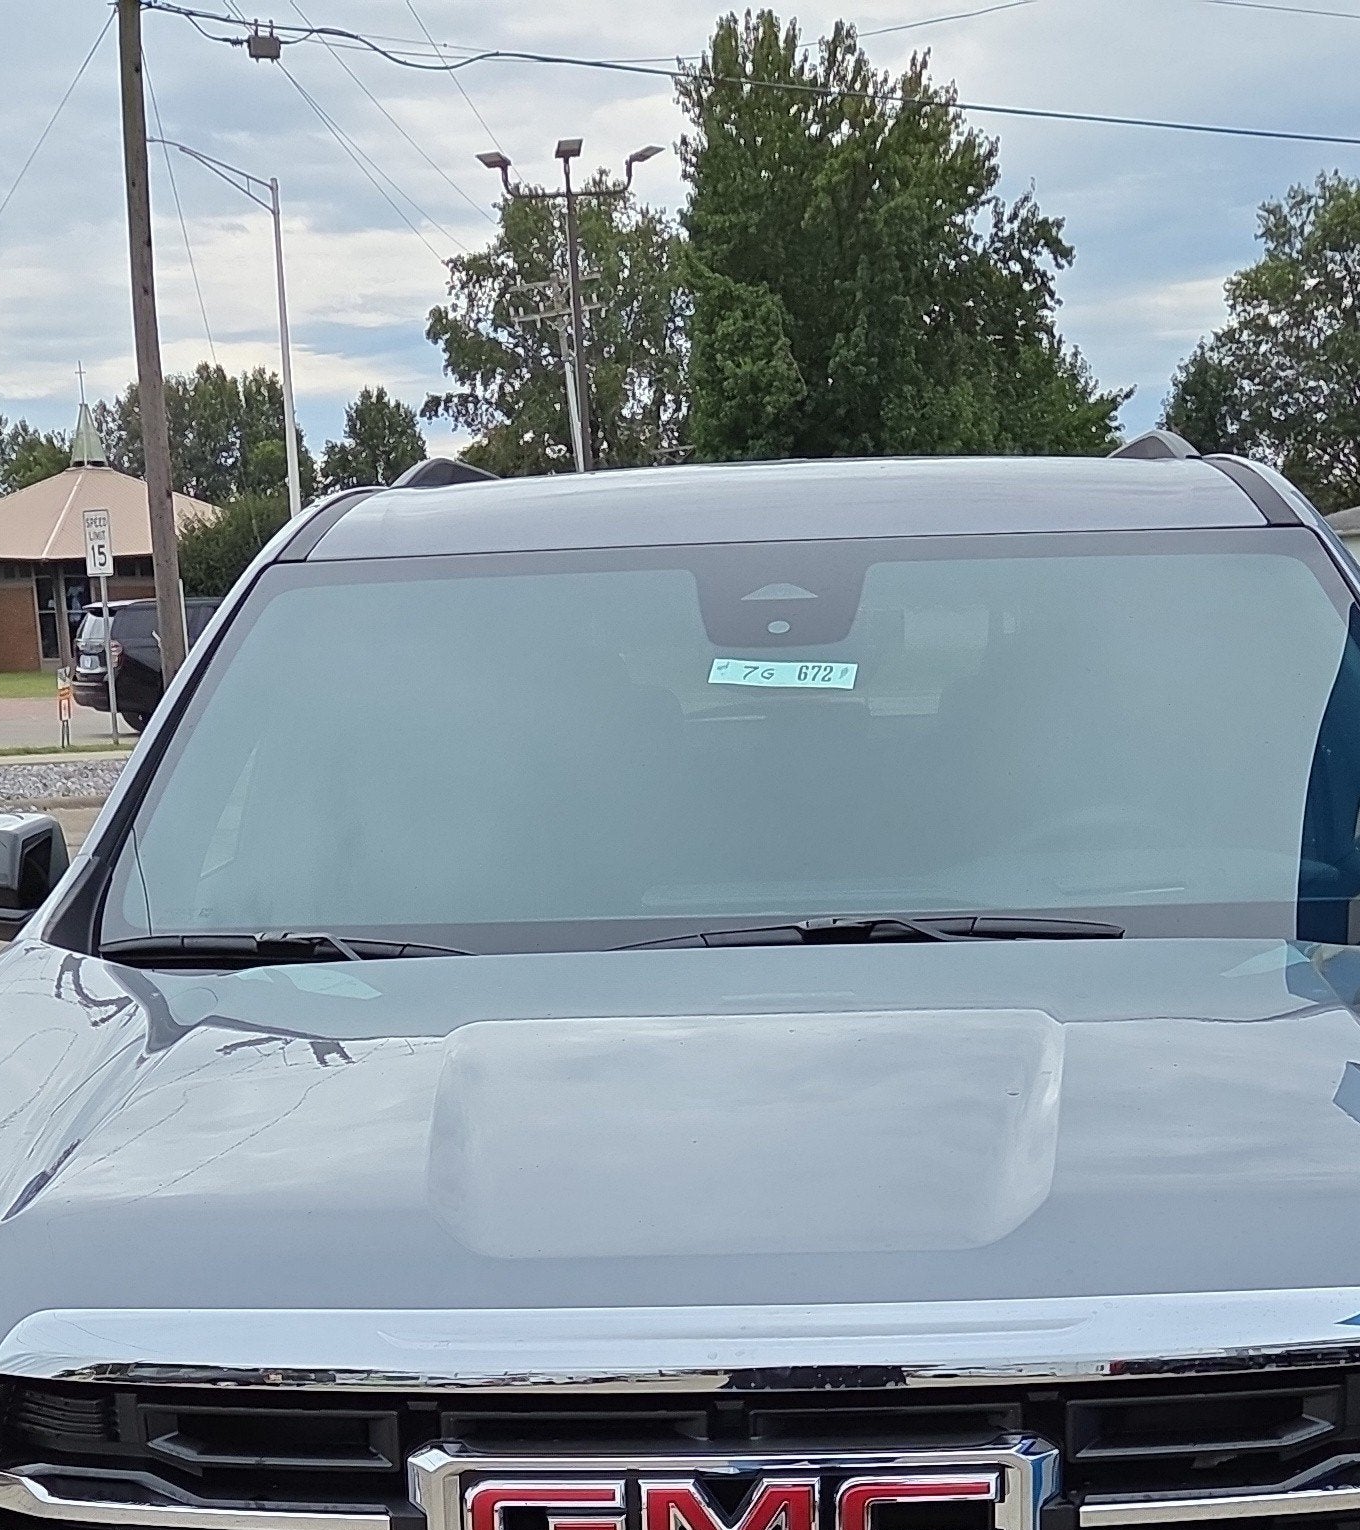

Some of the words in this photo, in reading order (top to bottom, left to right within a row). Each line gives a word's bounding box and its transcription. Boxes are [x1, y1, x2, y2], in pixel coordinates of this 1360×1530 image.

[86, 516, 107, 528] SPEED
[91, 544, 107, 567] 15
[797, 665, 834, 682] 672
